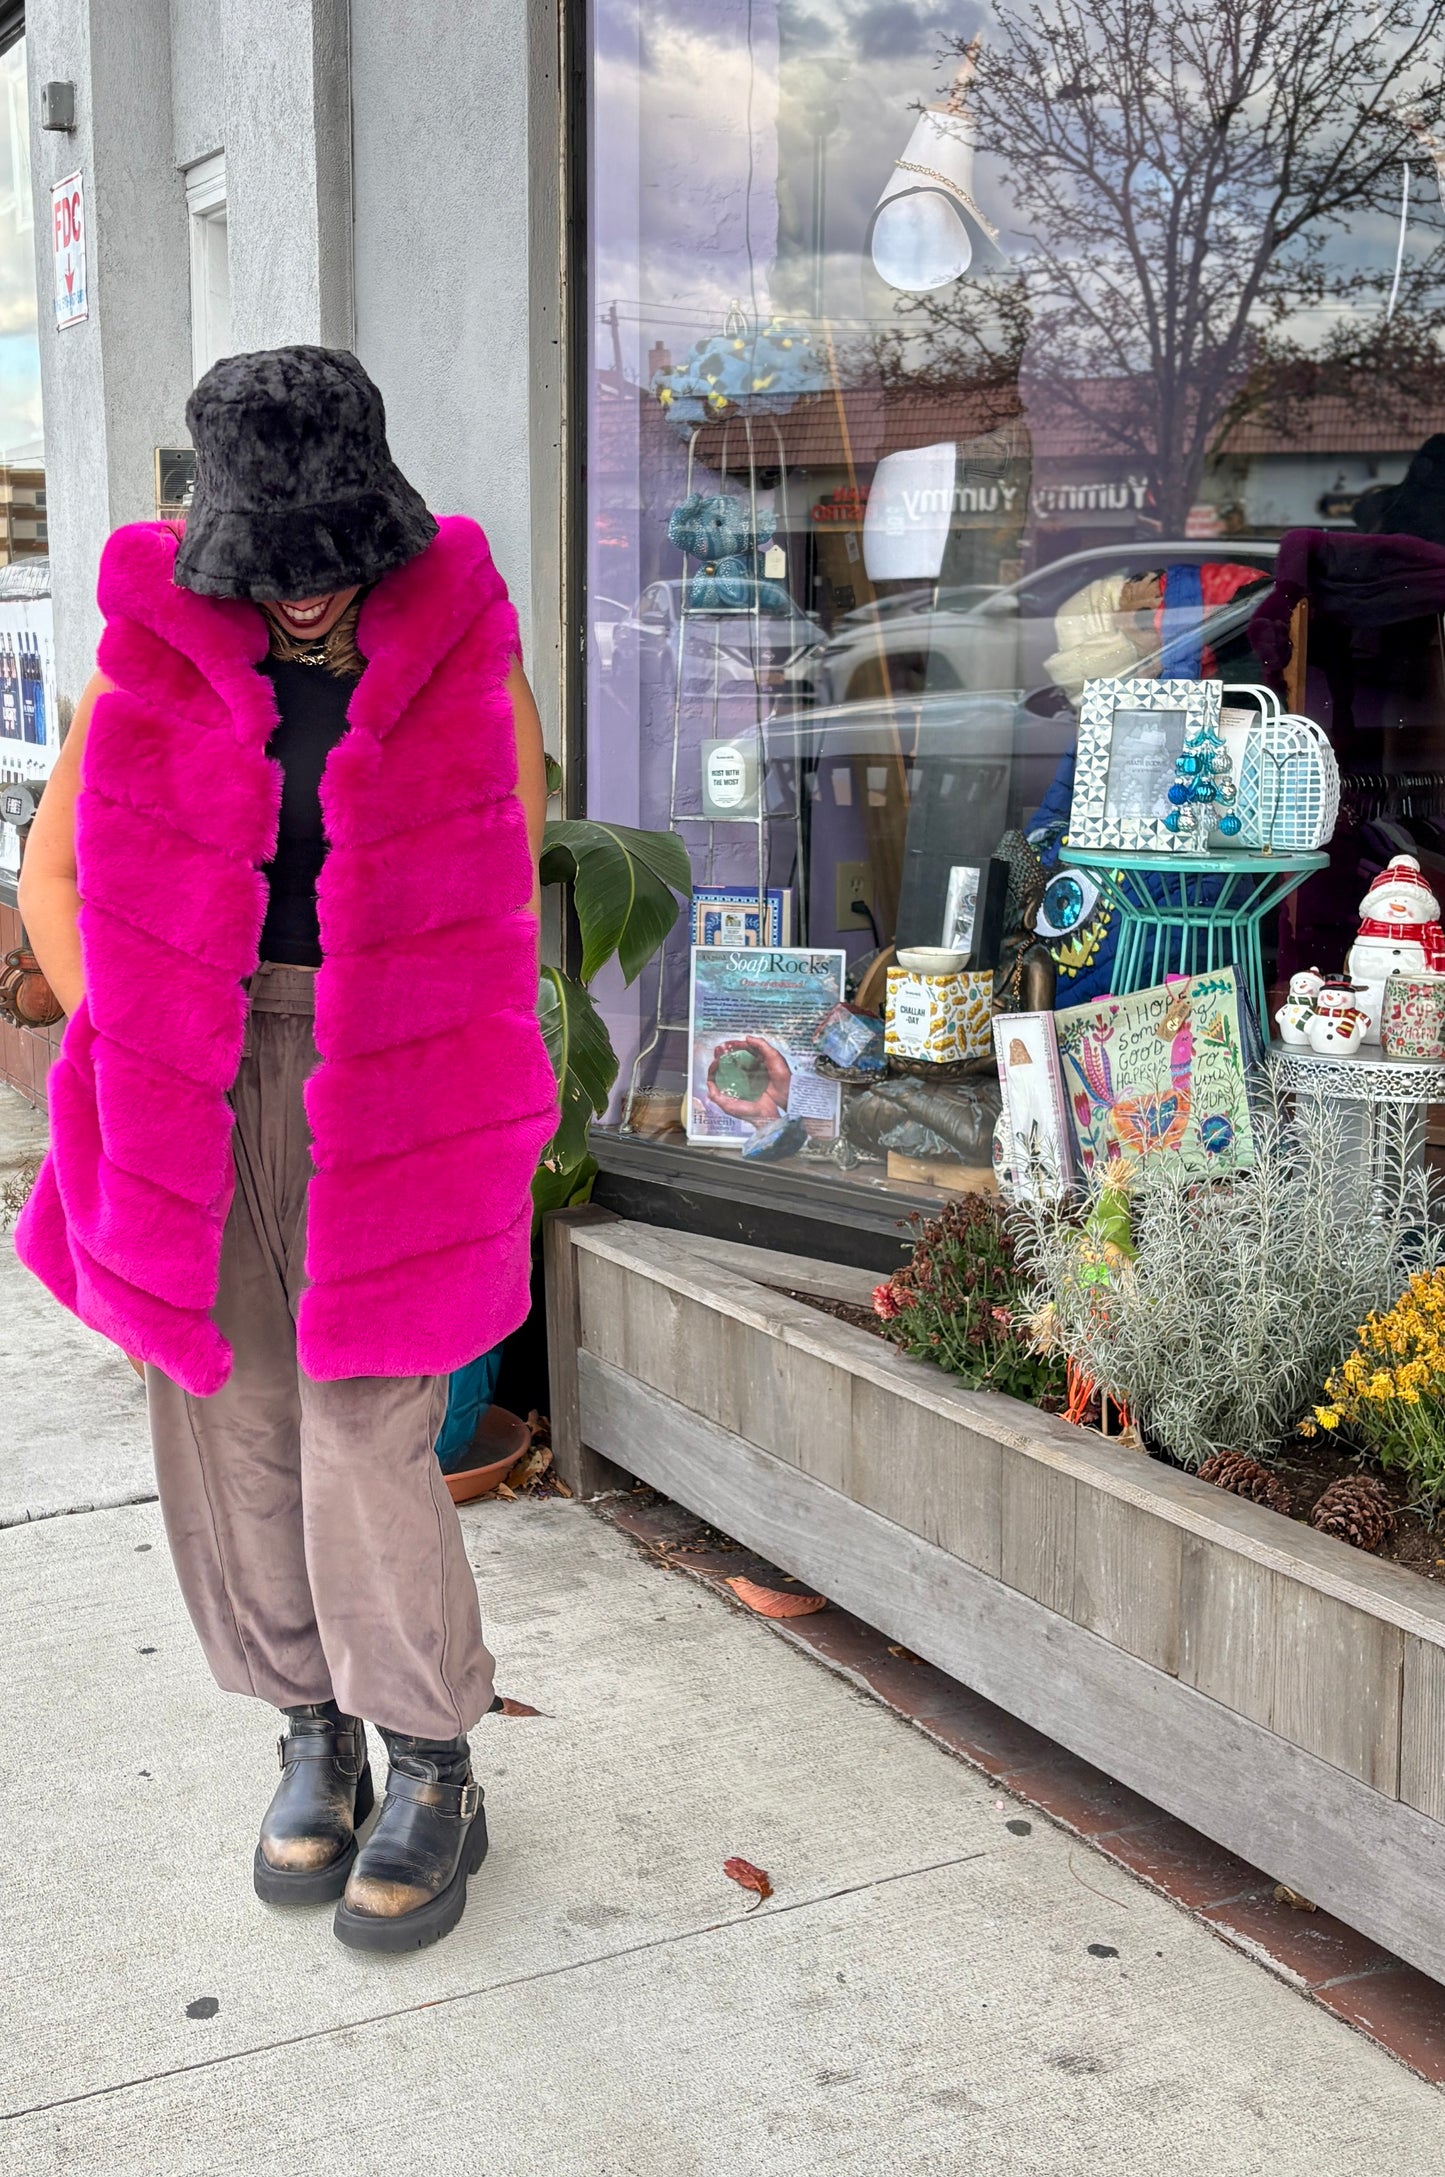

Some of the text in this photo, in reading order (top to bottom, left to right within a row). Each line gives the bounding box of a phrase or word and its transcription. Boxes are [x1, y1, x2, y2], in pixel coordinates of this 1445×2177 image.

[54, 191, 81, 252] FDC
[900, 1005, 926, 1016] CHALLAH
[1405, 1002, 1434, 1018] CUP
[1119, 1039, 1165, 1071] GOOD
[1197, 1051, 1220, 1071] TO
